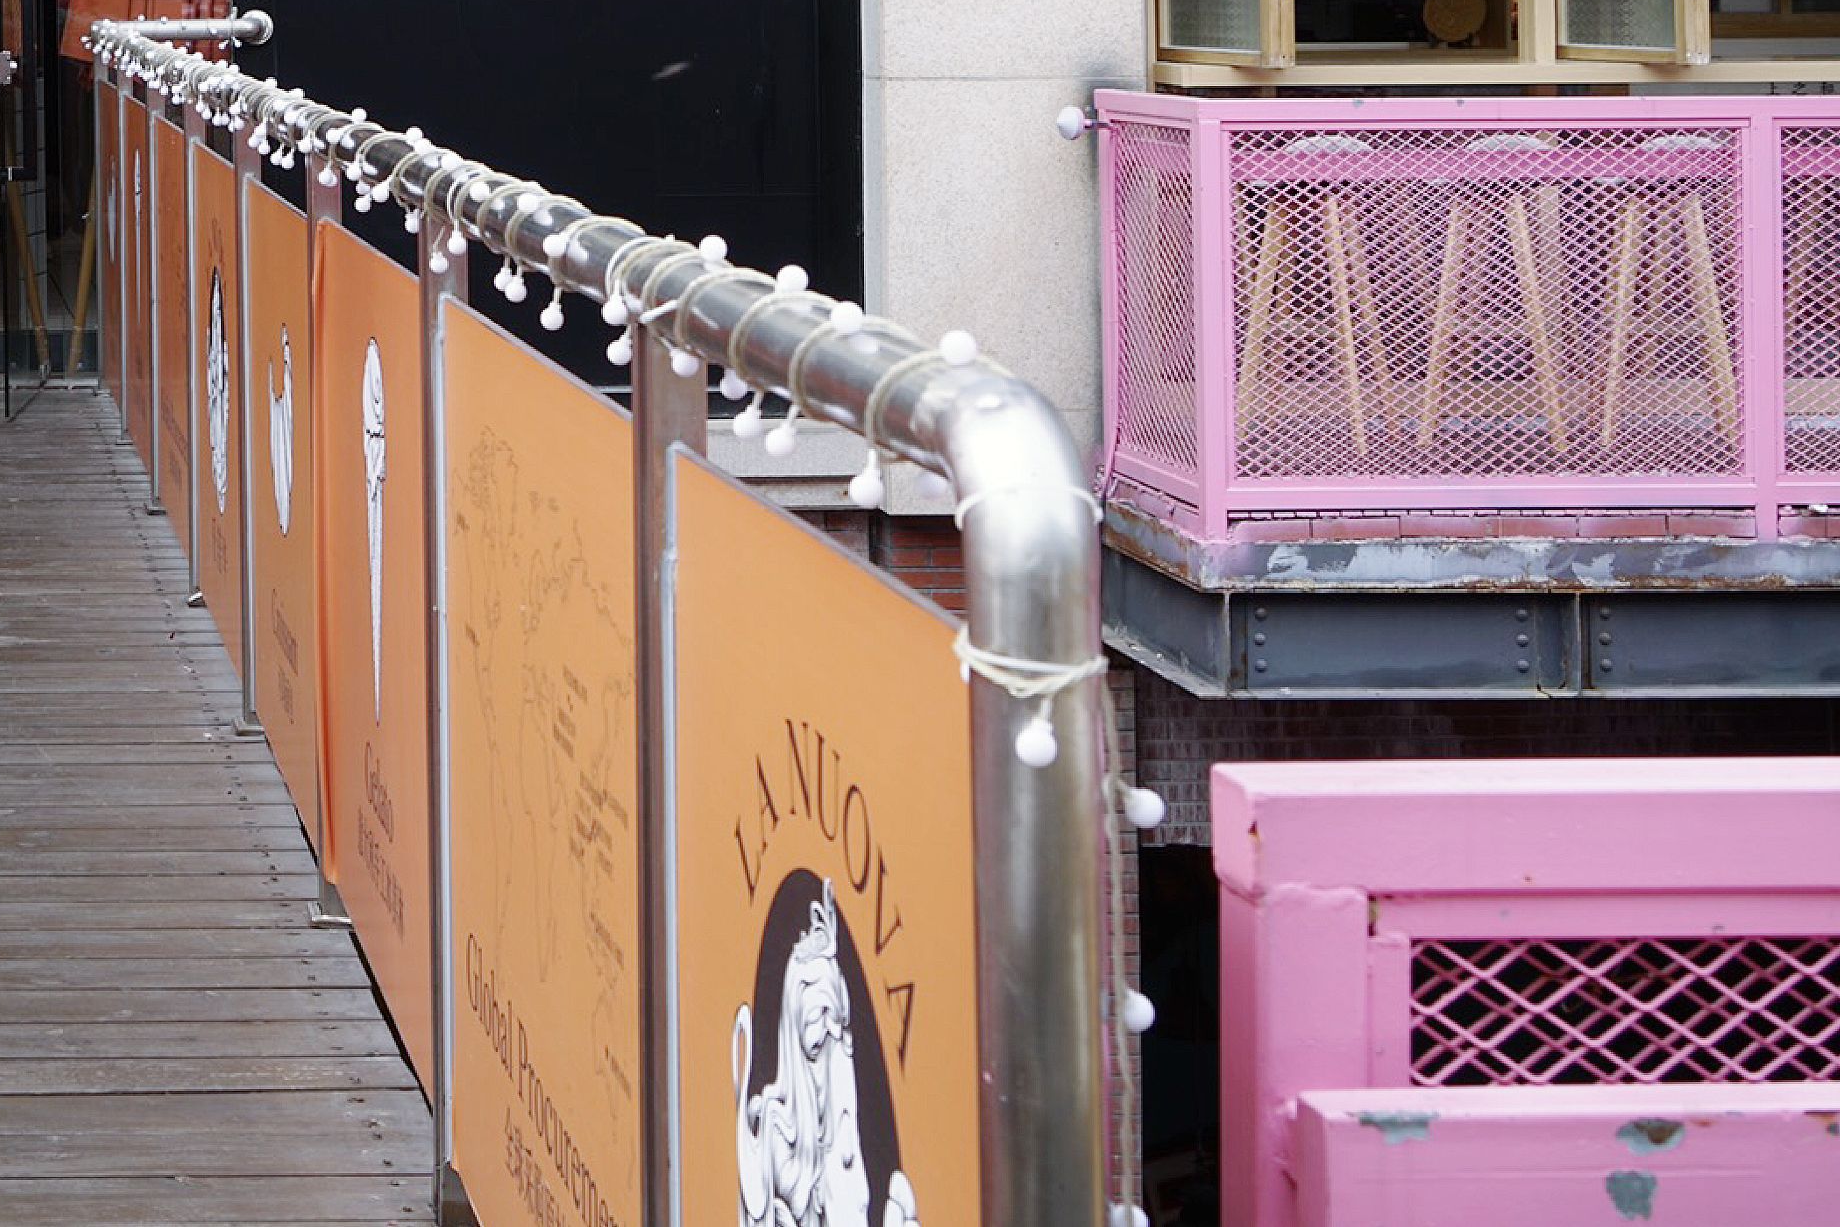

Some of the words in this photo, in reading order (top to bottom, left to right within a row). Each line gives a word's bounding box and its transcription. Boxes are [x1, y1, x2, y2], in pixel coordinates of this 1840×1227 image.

[733, 751, 780, 908] LA
[784, 717, 915, 1076] NUOVA
[465, 932, 514, 1083] Global
[516, 1018, 620, 1227] Procureme
